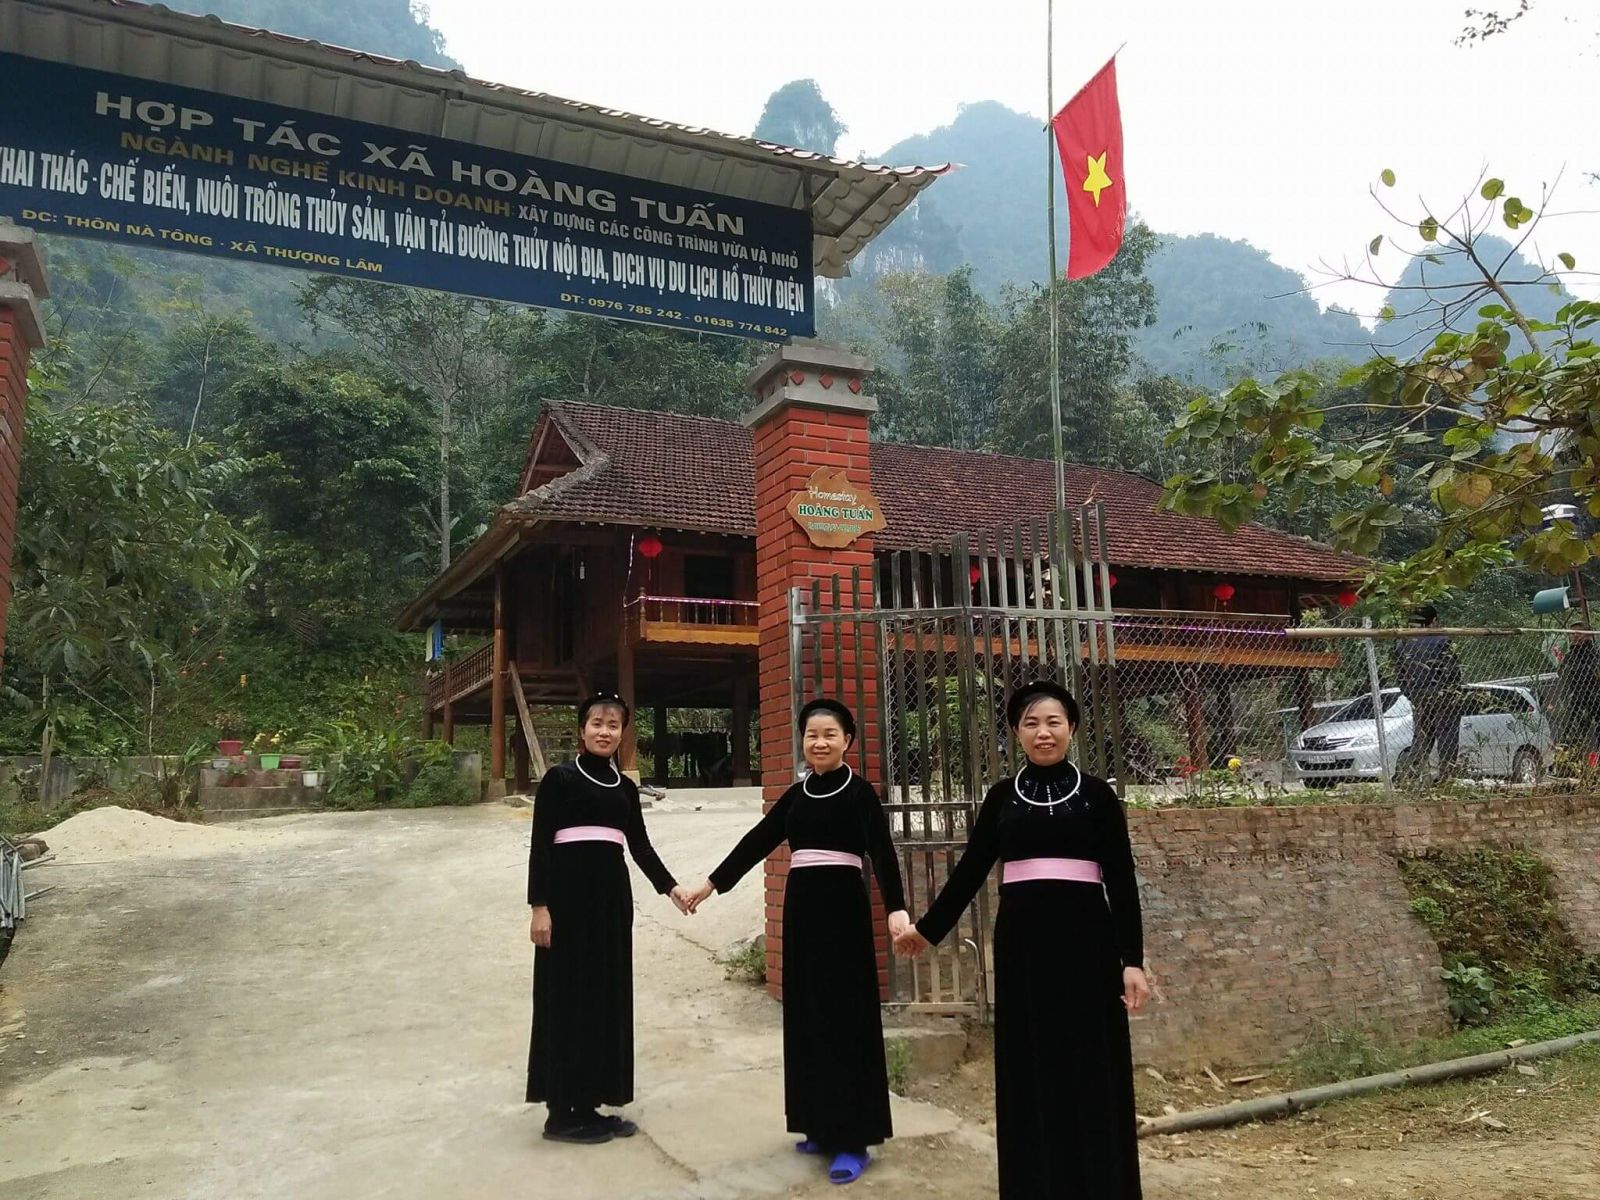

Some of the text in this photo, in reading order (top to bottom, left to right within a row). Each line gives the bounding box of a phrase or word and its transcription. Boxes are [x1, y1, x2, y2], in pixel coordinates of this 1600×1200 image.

[95, 91, 744, 235] HỢP TÁC XÃ HOÀNG TUẤN
[120, 131, 234, 165] NGÀNH
[248, 153, 329, 182] NGHỀ
[338, 169, 405, 197] KINH
[518, 205, 548, 224] XÂY
[553, 211, 595, 232] DỰNG
[600, 219, 629, 238] CÁC
[633, 226, 673, 245] CÔNG
[676, 233, 718, 255] TRÌNH
[722, 240, 748, 259] VỪA
[751, 246, 768, 263] VÀ
[771, 252, 799, 269] NHỎ
[0, 146, 34, 187] HAI
[41, 149, 89, 195] THÁC
[100, 158, 139, 202] CHẾ
[143, 164, 190, 216] BIẾN,
[196, 175, 239, 219] NUÔI
[244, 181, 300, 229] TRỒNG
[305, 188, 347, 236] THỦY
[352, 195, 390, 248] SẢN,
[395, 207, 425, 254] VẬN
[430, 209, 454, 255] TẢI
[458, 220, 508, 264] ĐƯỜNG
[512, 227, 549, 271] THỦY
[553, 239, 577, 280] NỘI
[581, 247, 609, 284] ĐỊA,
[613, 251, 644, 289] DỊCH
[647, 256, 665, 295] VỤ
[669, 262, 686, 294] DU
[689, 264, 718, 301] LỊCH
[722, 263, 739, 301] HỒ
[742, 265, 773, 307] THỦY
[776, 276, 805, 316] ĐIỆN
[63, 215, 120, 233] THÔN
[126, 223, 155, 238] NÀ
[159, 224, 213, 247] TÔNG
[229, 240, 257, 254] XÃ
[263, 245, 340, 267] THƯỢNG
[346, 257, 383, 273] LÂM
[588, 297, 623, 312] 0976
[627, 303, 653, 315] 785
[656, 308, 682, 320] 242
[694, 314, 734, 328] 01635
[738, 321, 761, 333] 774
[764, 325, 788, 337] 842
[798, 503, 874, 521] HOÀNG TUẤN
